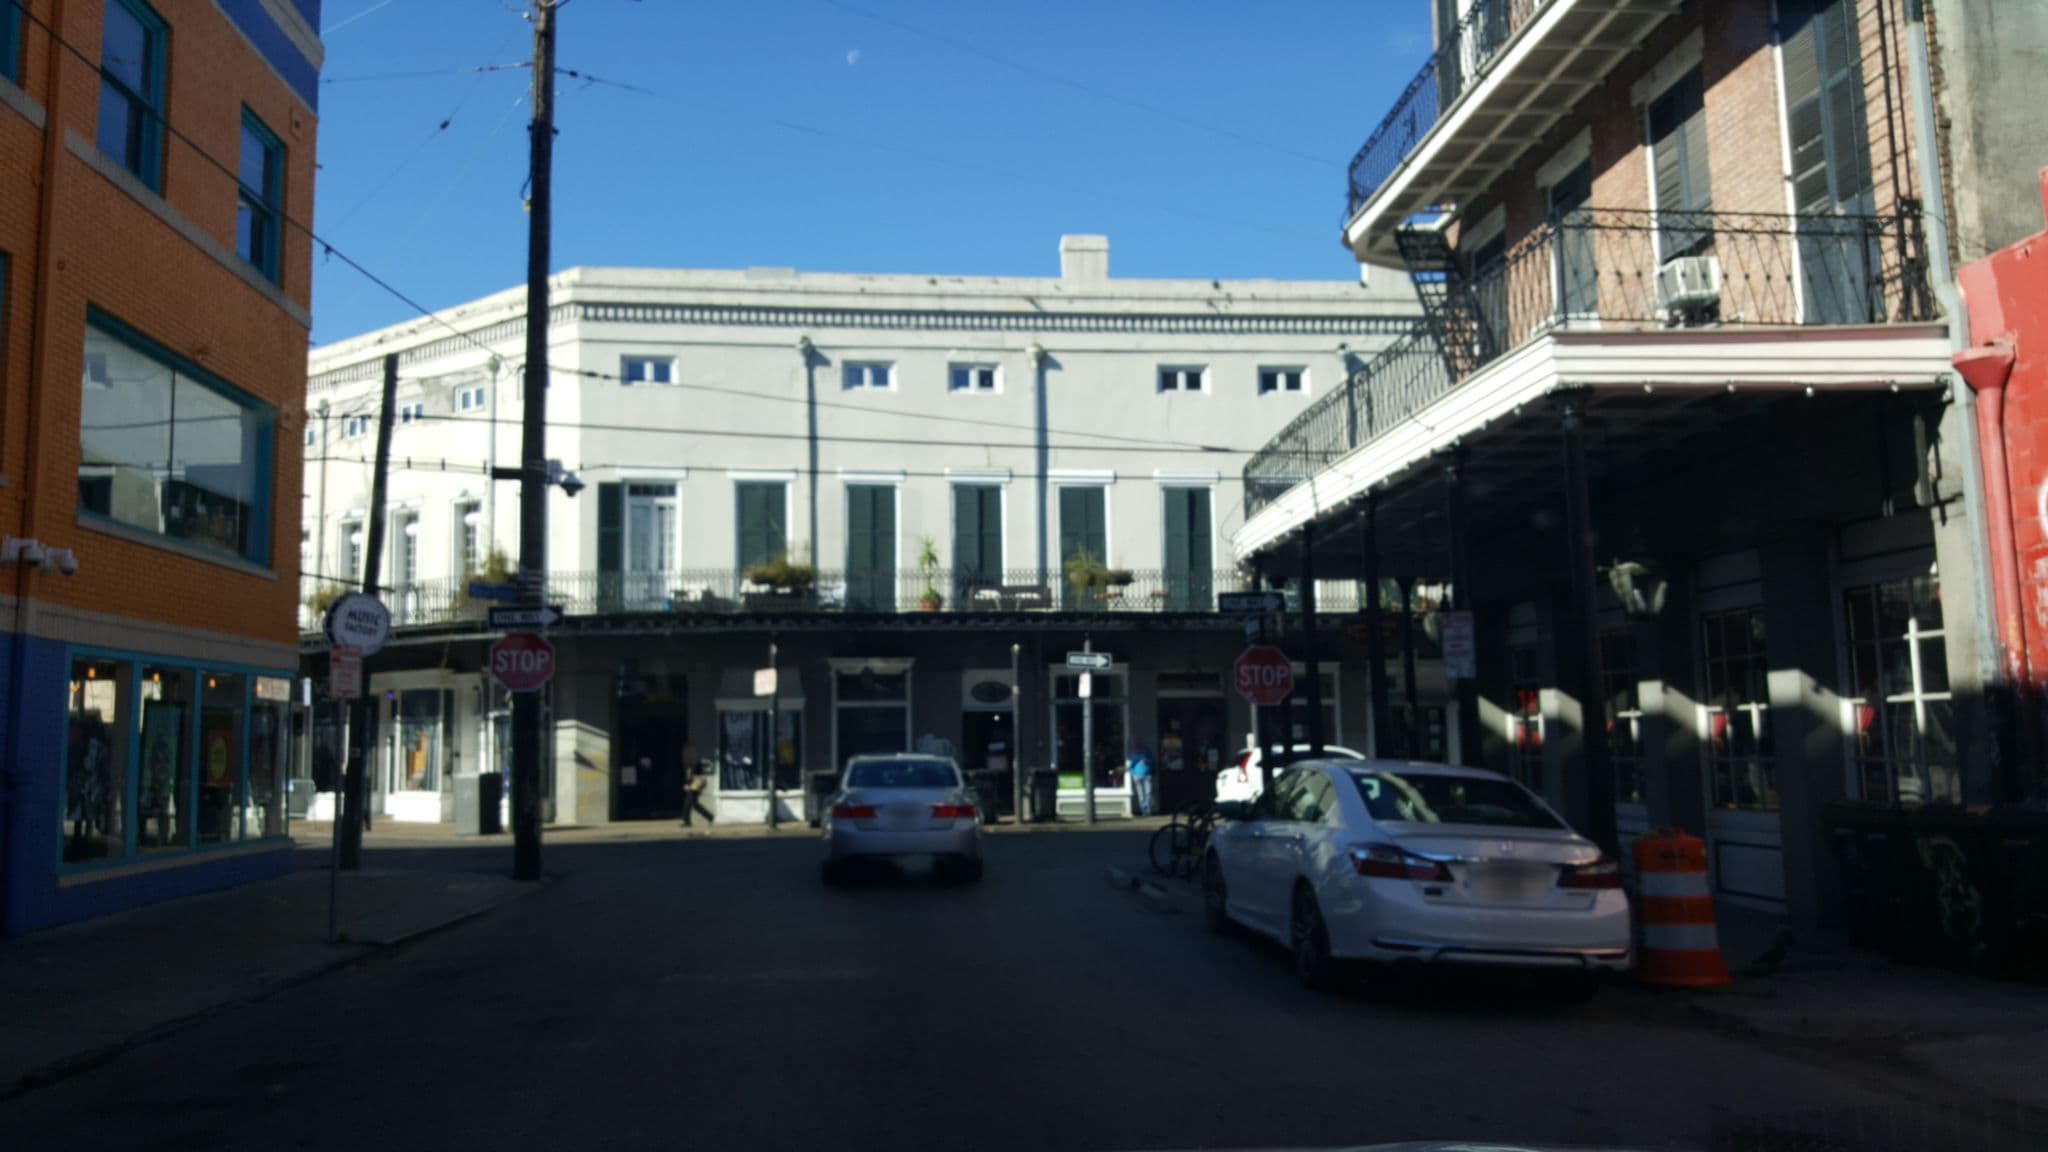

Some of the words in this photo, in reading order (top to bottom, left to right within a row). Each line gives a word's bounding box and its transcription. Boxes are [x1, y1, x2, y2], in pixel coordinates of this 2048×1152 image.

[347, 611, 380, 625] MUSIC
[345, 623, 378, 635] FACTORY
[495, 649, 551, 673] STOP
[1239, 663, 1289, 687] STOP
